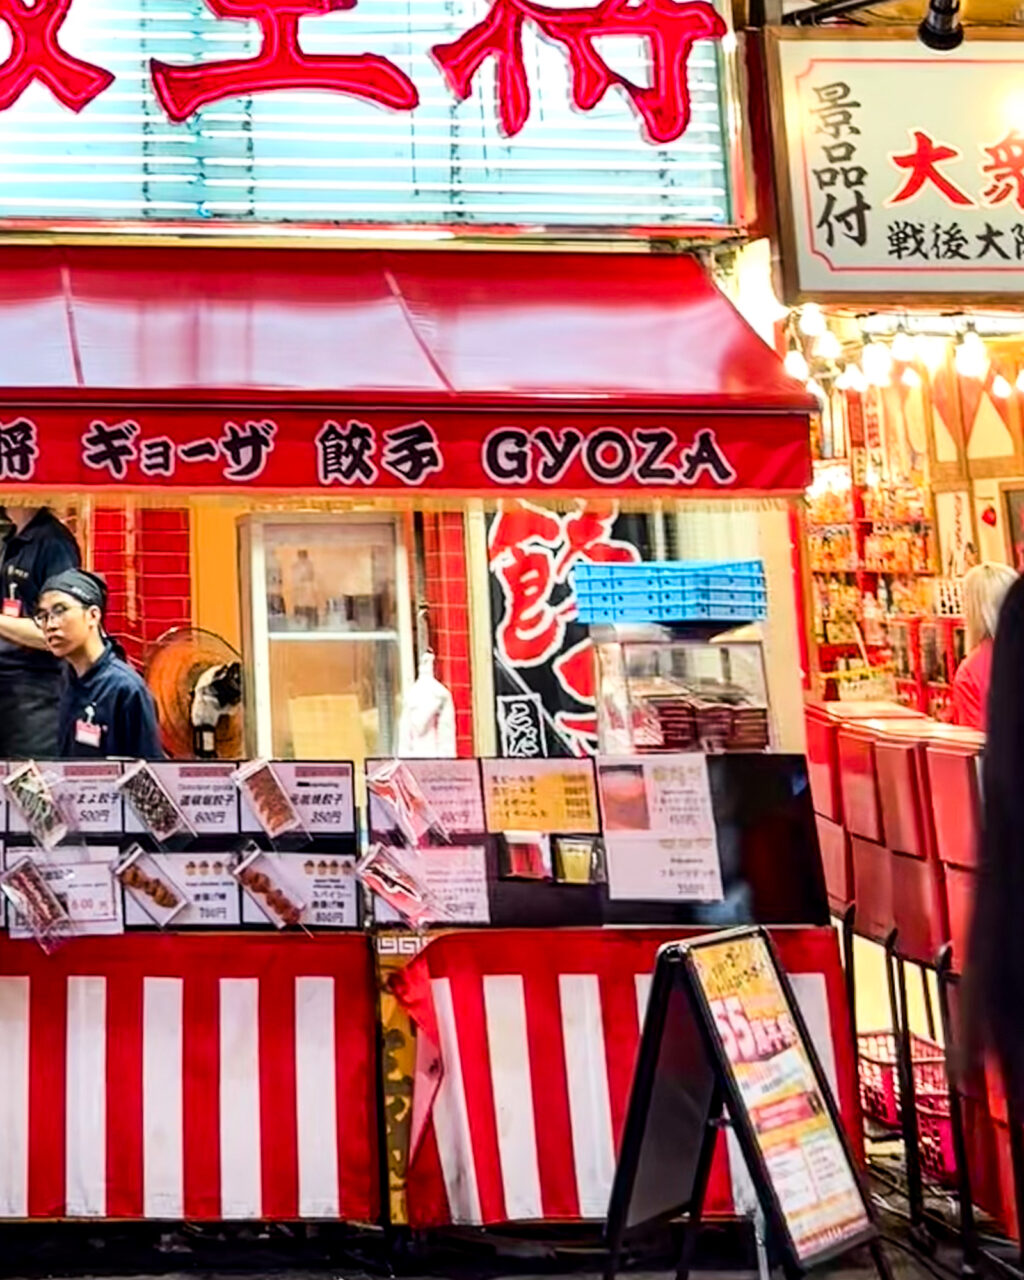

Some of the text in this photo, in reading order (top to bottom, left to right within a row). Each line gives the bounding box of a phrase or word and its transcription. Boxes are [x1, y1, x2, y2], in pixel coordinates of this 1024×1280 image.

[810, 81, 871, 247] 景品付
[83, 420, 278, 481] ギョーザ
[316, 422, 444, 485] 餃子
[482, 426, 736, 486] GYOZA
